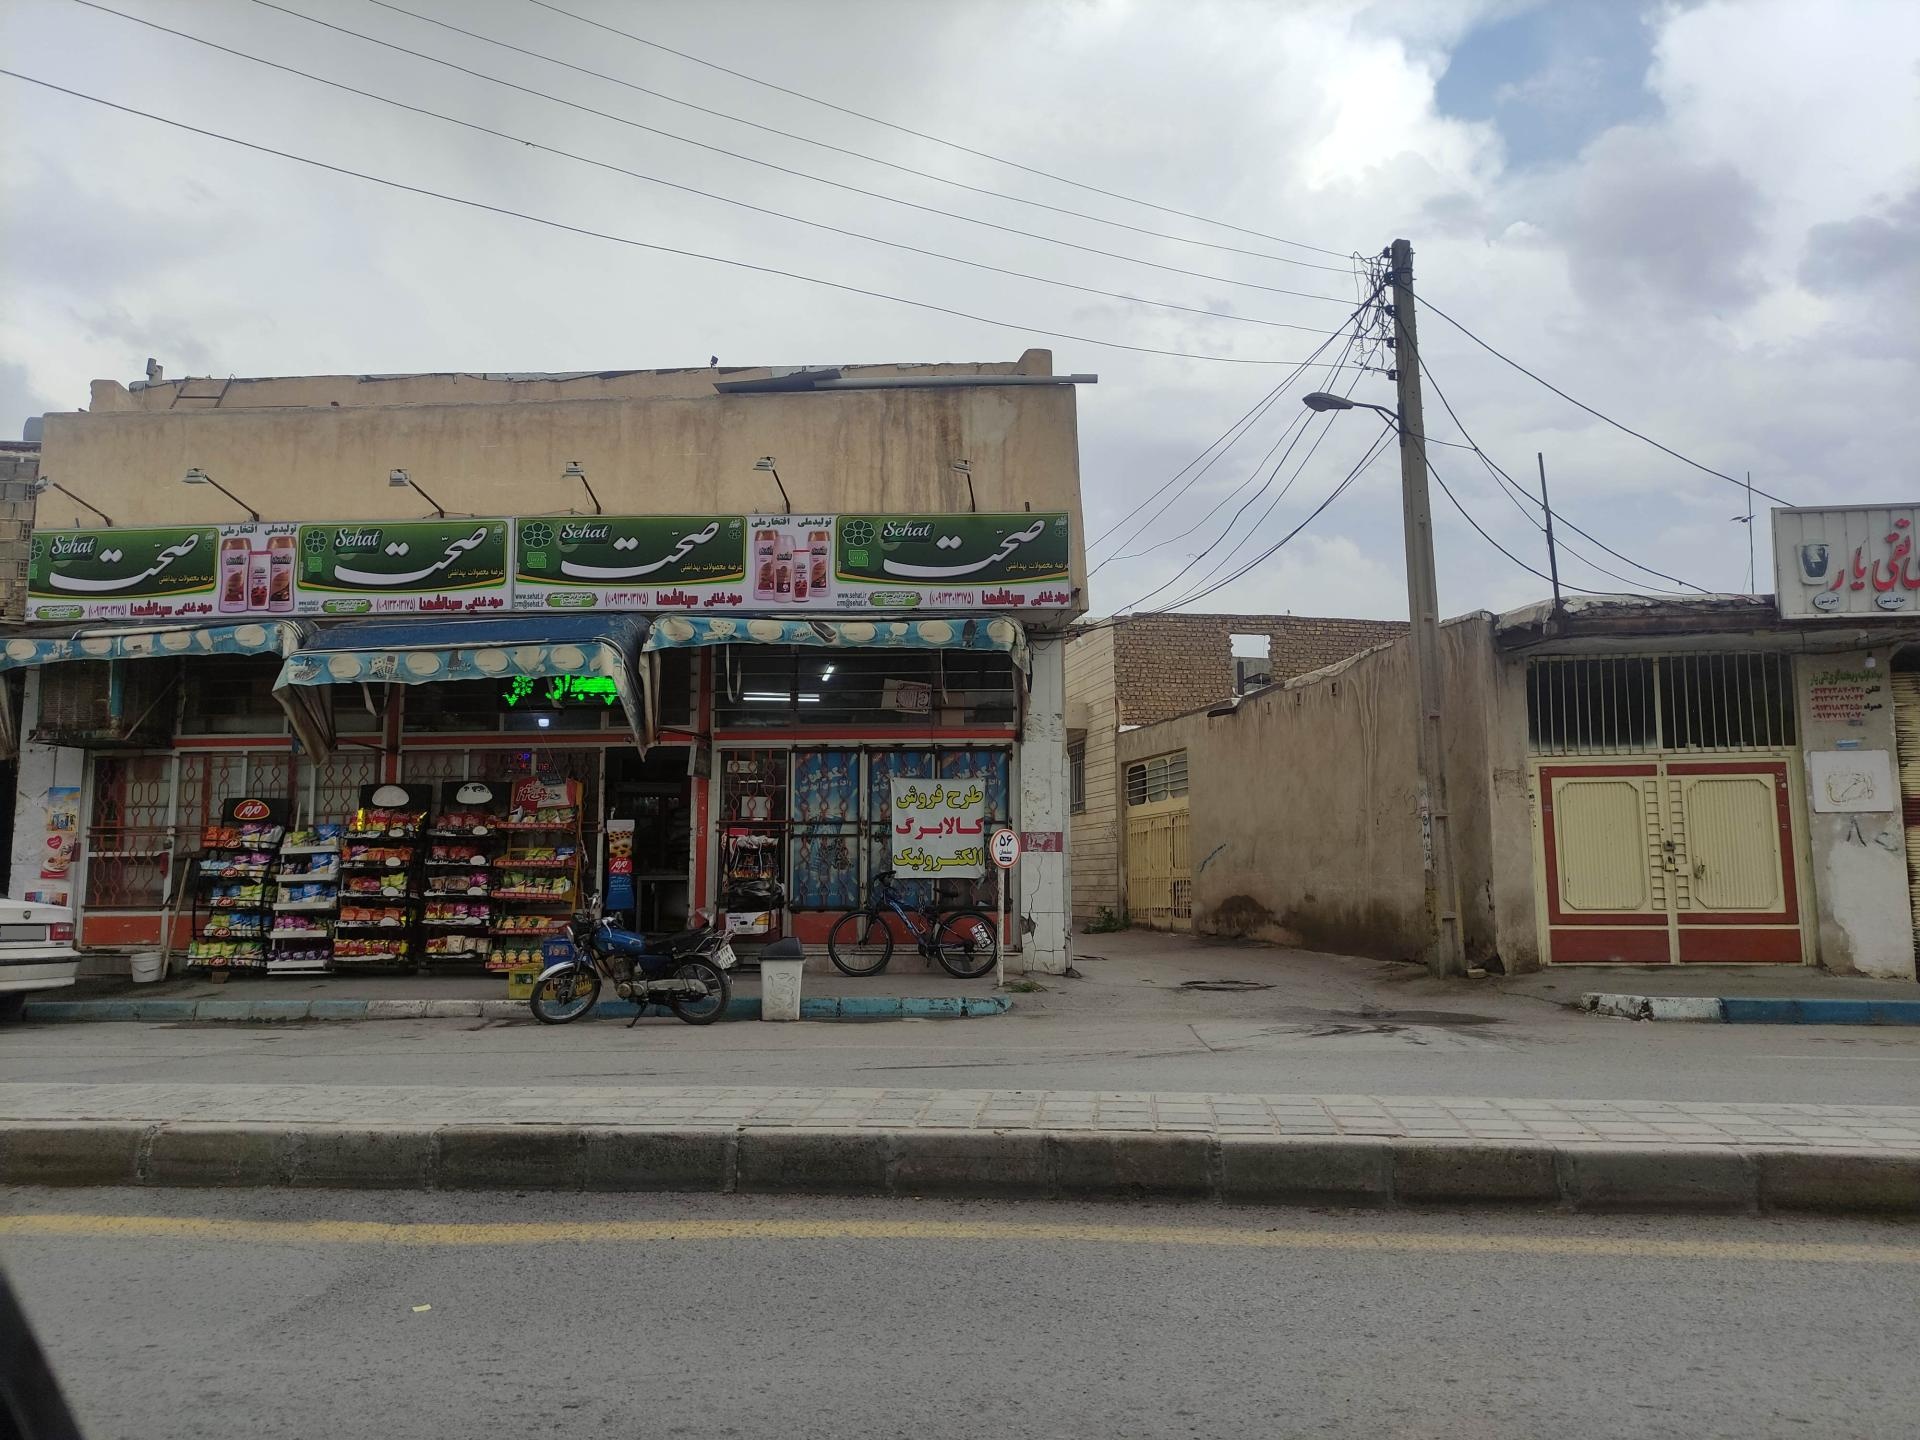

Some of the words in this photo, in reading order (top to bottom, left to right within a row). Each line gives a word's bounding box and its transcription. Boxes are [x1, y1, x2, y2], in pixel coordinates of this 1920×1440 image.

[562, 521, 608, 539] Sehat
[883, 521, 930, 537] Sehat
[51, 536, 95, 555] Sehat
[335, 528, 380, 548] Sehat
[465, 596, 486, 611] غذایی
[488, 596, 503, 608] مواد
[704, 592, 726, 607] غذایی
[726, 592, 742, 606] مواد
[1031, 591, 1054, 606] غذایی
[174, 602, 196, 615] غذایی
[197, 602, 213, 614] مواد
[896, 784, 944, 810] فروش
[946, 784, 984, 809] طرح
[999, 834, 1013, 847] ۵۶
[893, 847, 984, 872] الکترونیک
